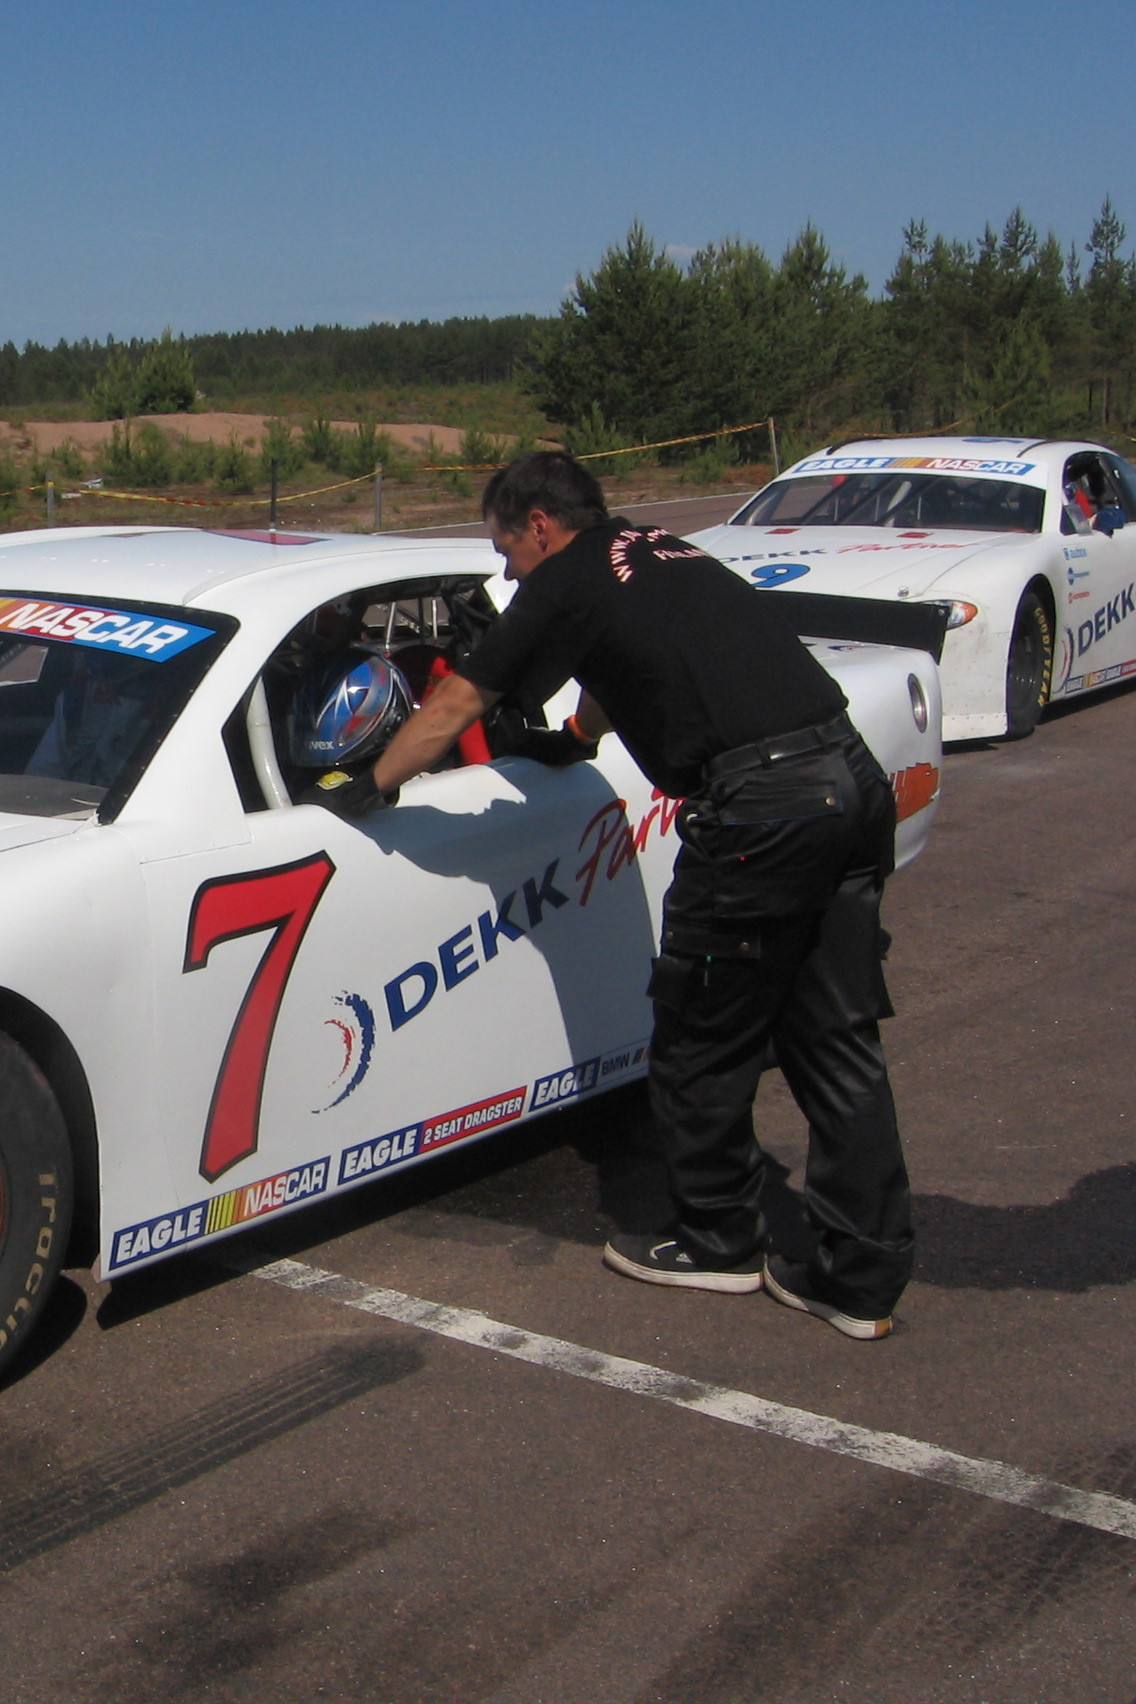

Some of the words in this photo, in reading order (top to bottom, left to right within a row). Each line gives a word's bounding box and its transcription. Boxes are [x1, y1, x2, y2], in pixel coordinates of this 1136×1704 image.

[800, 458, 890, 471] EAGLE
[926, 458, 1027, 474] NASCAR
[751, 563, 811, 588] 9
[1078, 583, 1135, 657] DEKK
[384, 858, 569, 1032] DEKK
[182, 850, 336, 1183] 7
[534, 1064, 597, 1106] EAGLE
[343, 1127, 417, 1178] EAGLE
[423, 1127, 433, 1144] 2
[434, 1117, 462, 1142] SEAT
[464, 1096, 523, 1134] DRAGSTER
[117, 1206, 204, 1265] EAGLE
[243, 1167, 325, 1218] NASCAR
